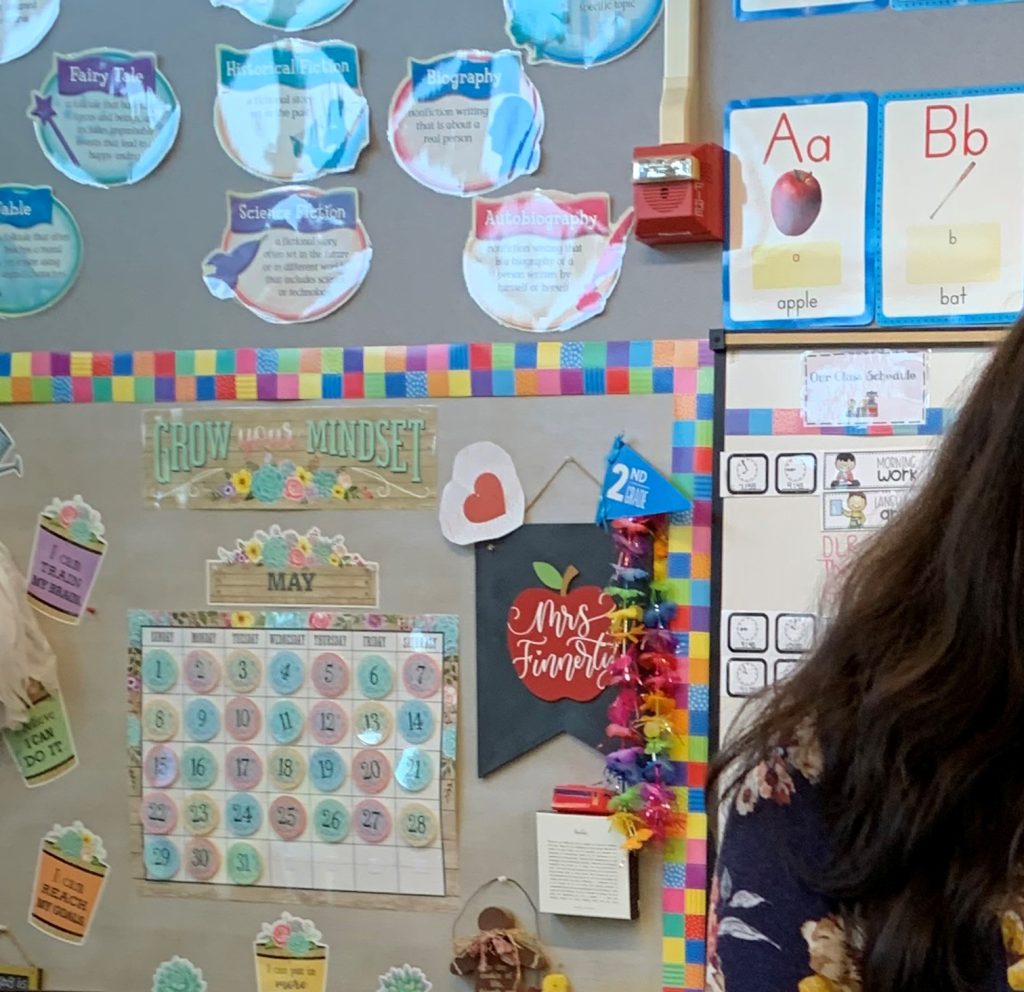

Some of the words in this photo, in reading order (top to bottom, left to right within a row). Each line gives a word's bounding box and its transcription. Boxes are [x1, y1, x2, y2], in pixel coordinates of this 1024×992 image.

[69, 65, 109, 87] Fairy
[113, 66, 144, 82] Tale
[226, 59, 295, 77] Historical
[301, 58, 349, 74] Fiction
[427, 67, 502, 90] Biography
[456, 108, 488, 118] writing
[416, 121, 434, 130] that
[446, 120, 472, 130] about
[924, 103, 988, 159] Bb
[442, 135, 472, 146] person
[763, 112, 831, 165] Aa
[0, 199, 32, 216] able
[238, 203, 291, 220] Science
[296, 203, 346, 220] Fiction
[484, 209, 598, 231] Autobiography
[949, 229, 957, 245] b
[777, 291, 818, 317] apple
[940, 287, 968, 305] bat
[866, 369, 917, 381] Schedule
[153, 420, 232, 484] GROW
[306, 419, 426, 483] MINDSET
[877, 456, 916, 469] MORNING
[878, 469, 918, 482] work
[31, 573, 49, 590] MY
[41, 560, 83, 588] TRAIN
[267, 571, 316, 592] MAY
[156, 660, 162, 679] 1
[196, 660, 205, 679] 2
[238, 660, 248, 679] 3
[280, 663, 290, 680] 4
[324, 664, 333, 683] 5
[370, 665, 379, 685] 6
[416, 665, 426, 684] 7
[155, 710, 164, 729] 8
[198, 709, 207, 727] 9
[235, 709, 250, 728] 10
[279, 711, 293, 730] 11
[320, 712, 335, 732] 12
[364, 712, 380, 731] 13
[408, 712, 423, 731] 14
[23, 750, 46, 768] DO
[48, 740, 63, 756] IT
[154, 757, 167, 776] 15
[191, 757, 206, 777] 16
[235, 758, 250, 777] 17
[278, 758, 293, 777] 18
[318, 759, 334, 779] 19
[361, 760, 380, 780] 20
[149, 802, 166, 822] 22
[190, 803, 209, 823] 23
[232, 804, 253, 823] 24
[277, 806, 296, 826] 25
[321, 809, 340, 830] 26
[362, 809, 381, 830] 27
[408, 814, 426, 833] 28
[153, 847, 170, 866] 29
[191, 848, 209, 867] 30
[236, 852, 251, 872] 31
[41, 883, 88, 912] REACH
[36, 897, 53, 912] MY
[53, 905, 85, 927] GOALS
